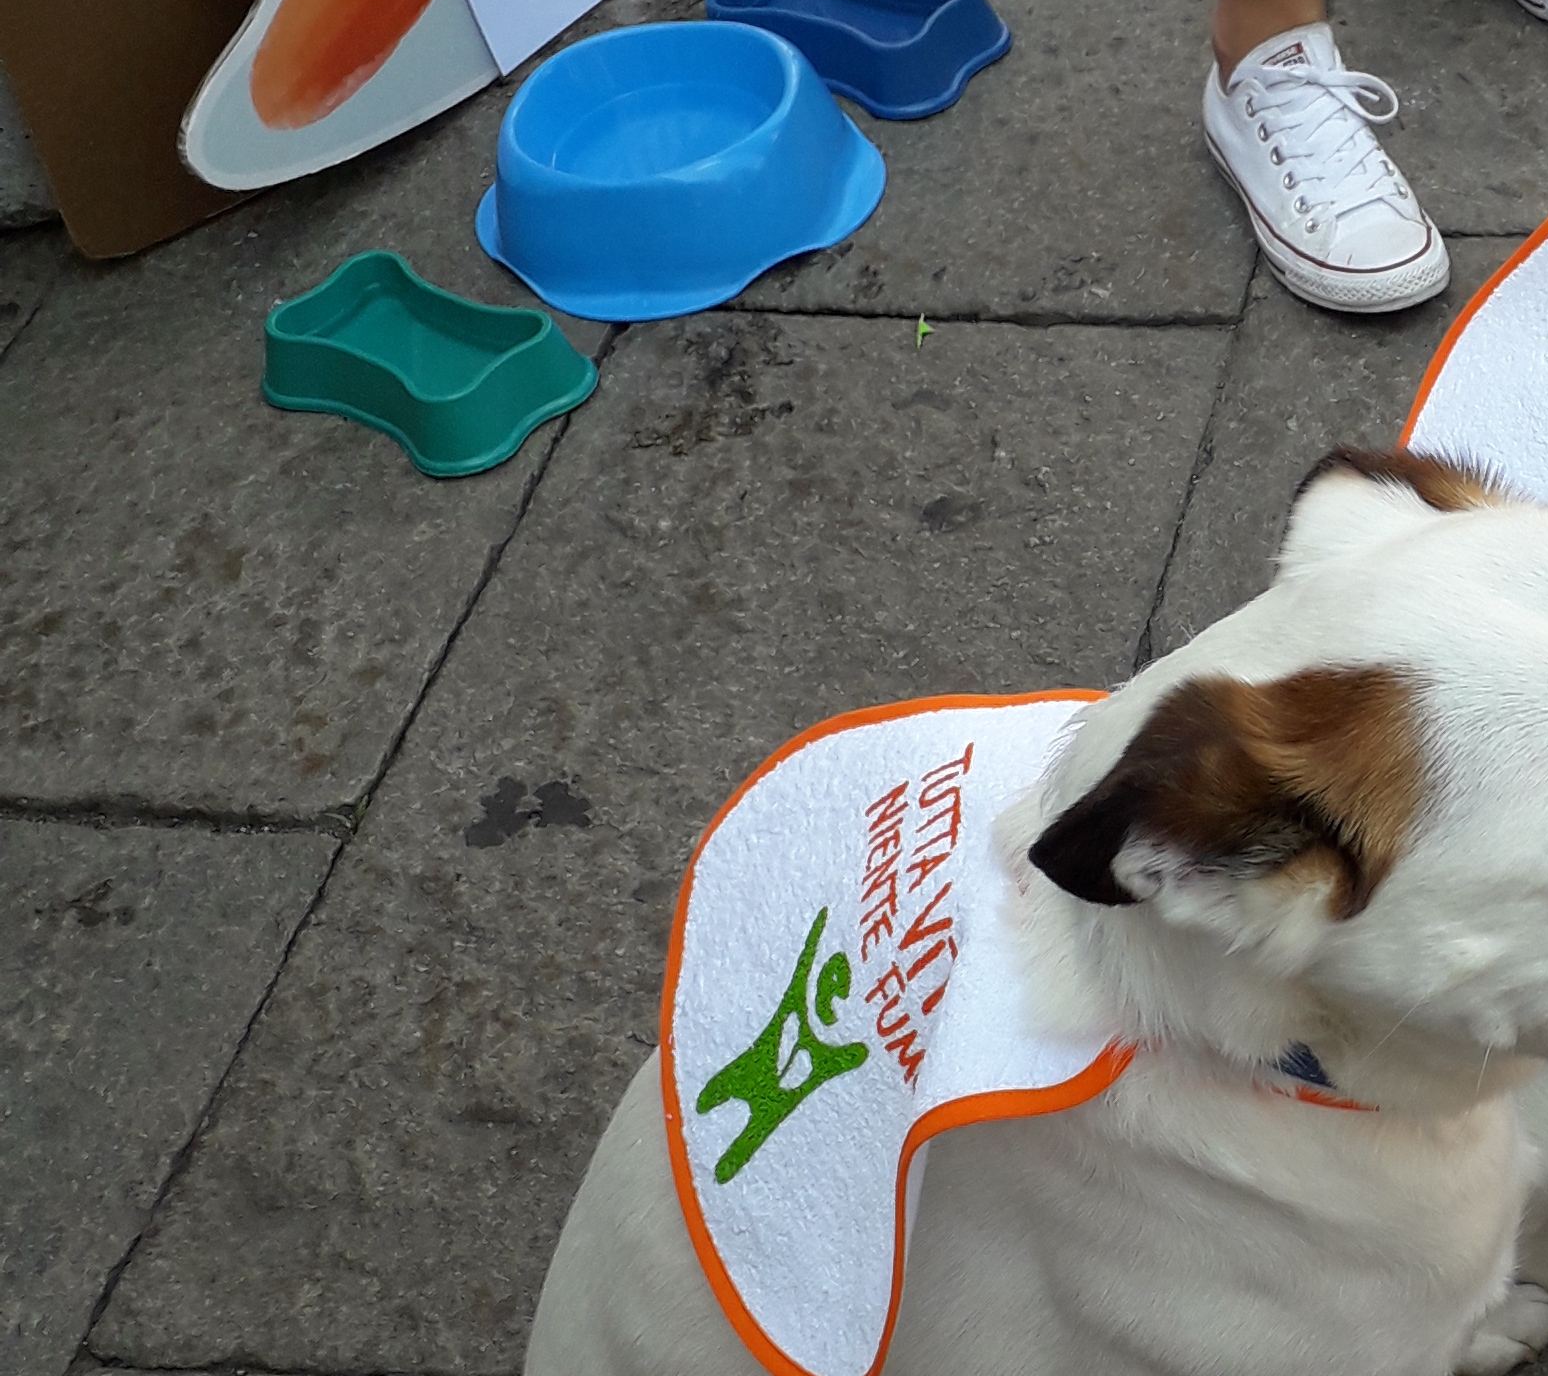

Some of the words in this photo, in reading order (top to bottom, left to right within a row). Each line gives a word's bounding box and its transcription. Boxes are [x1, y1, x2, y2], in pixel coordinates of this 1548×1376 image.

[860, 780, 911, 962] NIENTE
[906, 741, 975, 893] TUTTA
[864, 960, 926, 1096] FUM
